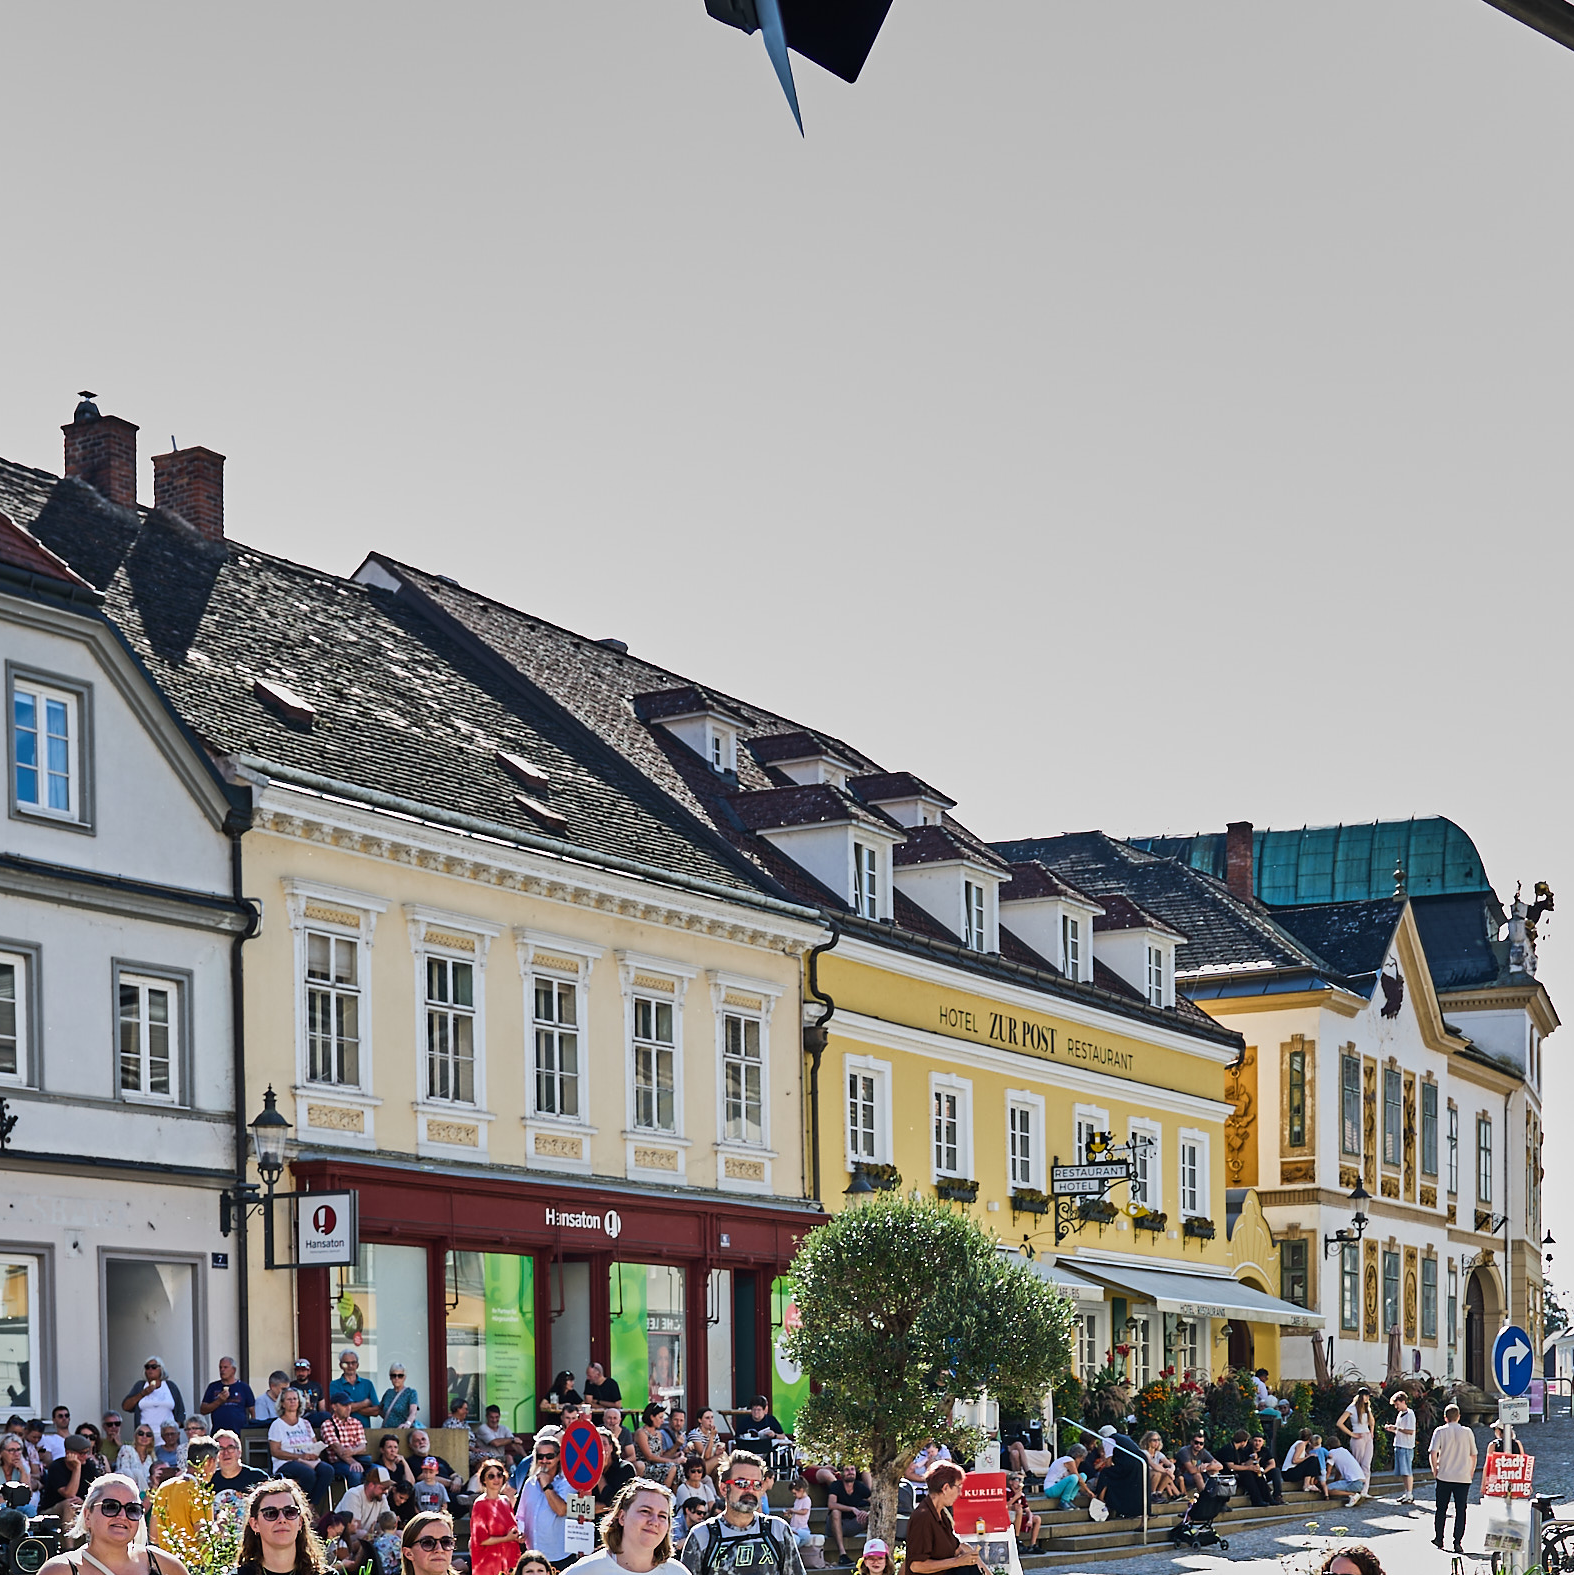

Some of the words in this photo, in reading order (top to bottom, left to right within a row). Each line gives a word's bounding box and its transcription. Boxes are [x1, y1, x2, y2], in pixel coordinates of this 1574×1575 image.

[939, 1005, 979, 1033] HOTEL
[989, 1012, 1019, 1046] ZUR
[1022, 1021, 1058, 1054] POST
[1067, 1038, 1134, 1071] RESTAURANT
[1054, 1166, 1125, 1178] RESTAURANT
[1059, 1181, 1094, 1191] HOTEL
[305, 1238, 345, 1249] Hansaton
[217, 1254, 223, 1263] 7
[1180, 1304, 1195, 1315] HOTEL
[1197, 1305, 1226, 1317] RESTAURANT
[1495, 1455, 1525, 1468] stadt
[1497, 1467, 1523, 1480] land
[1525, 1456, 1534, 1481] GRATIS
[964, 1487, 1004, 1497] KURIER
[1488, 1482, 1531, 1496] zeitung
[571, 1498, 591, 1514] Ende
